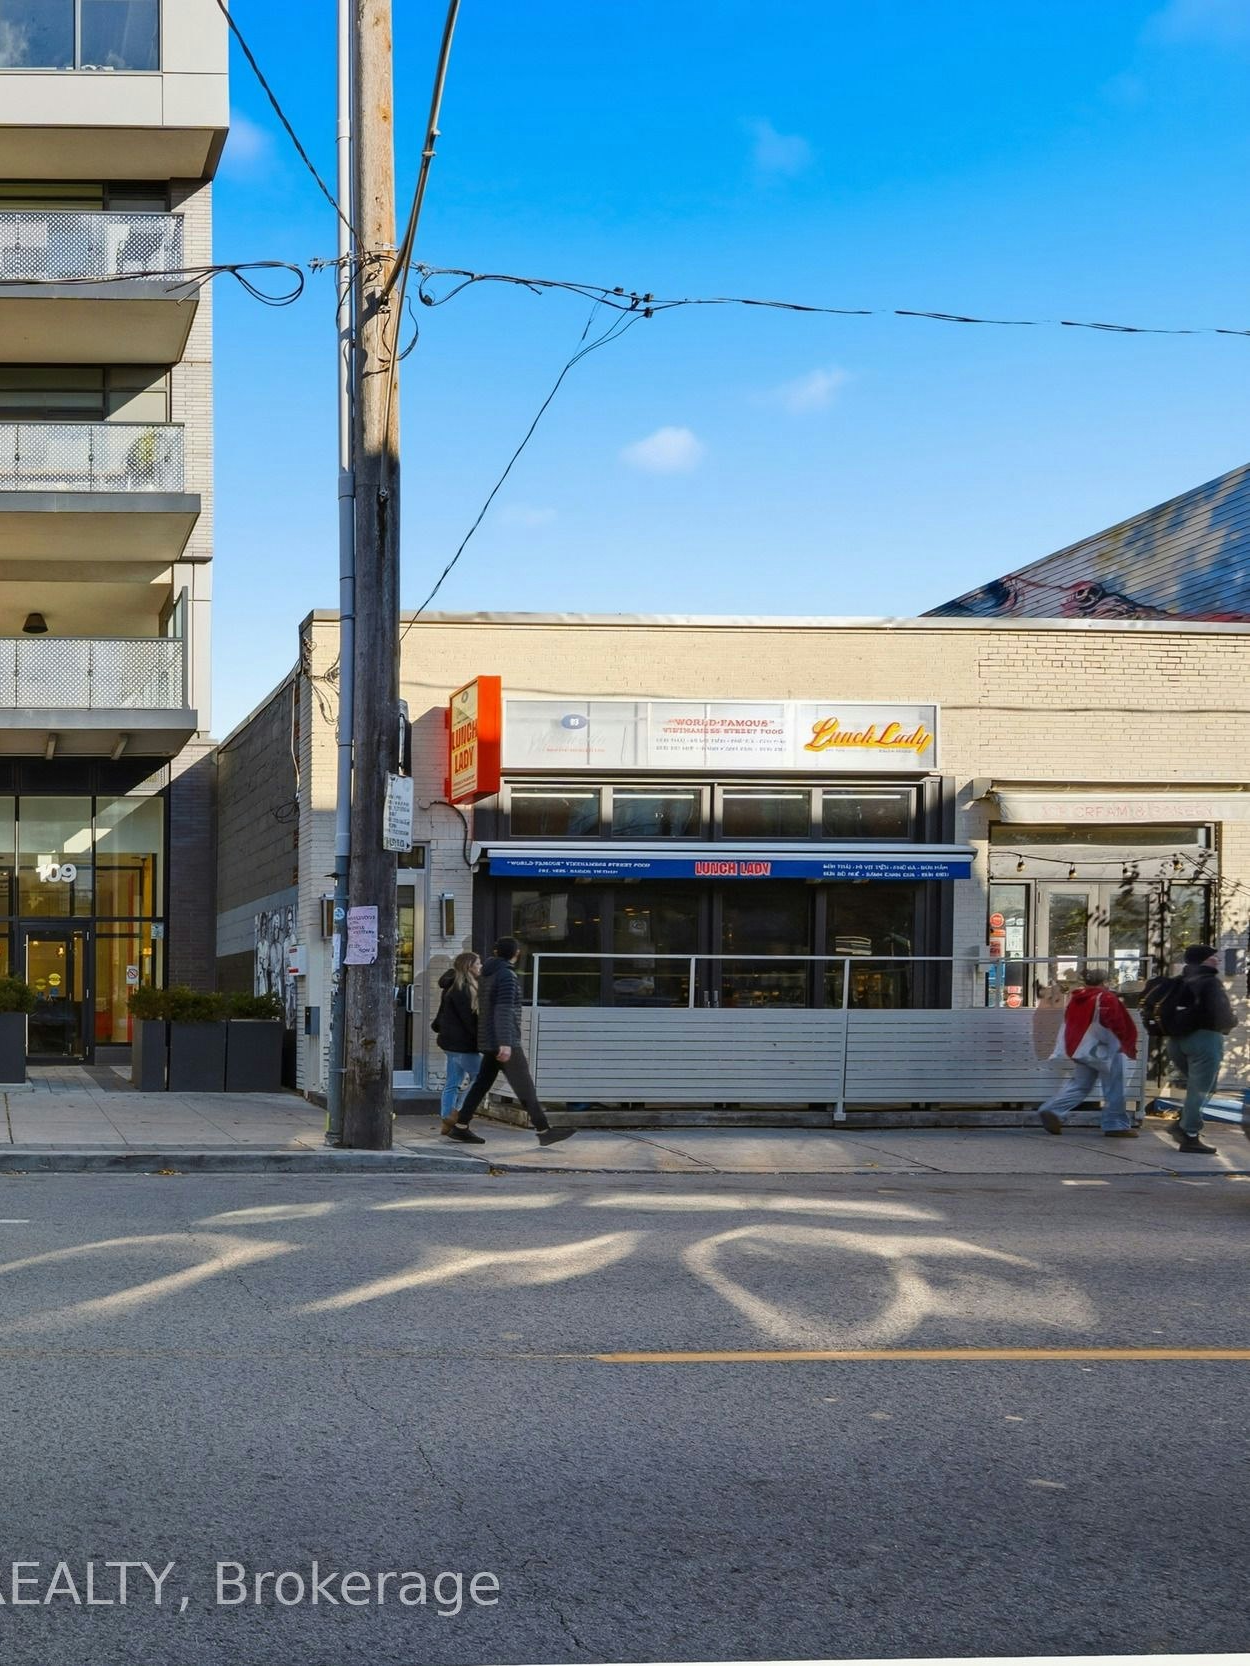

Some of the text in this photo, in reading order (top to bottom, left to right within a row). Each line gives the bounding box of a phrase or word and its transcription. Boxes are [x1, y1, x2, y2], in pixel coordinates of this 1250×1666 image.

[451, 718, 478, 750] LUNCH
[804, 716, 933, 756] Lunch Lady
[454, 745, 474, 775] LADY
[35, 863, 77, 883] 109
[695, 860, 771, 876] LUNCH LADY
